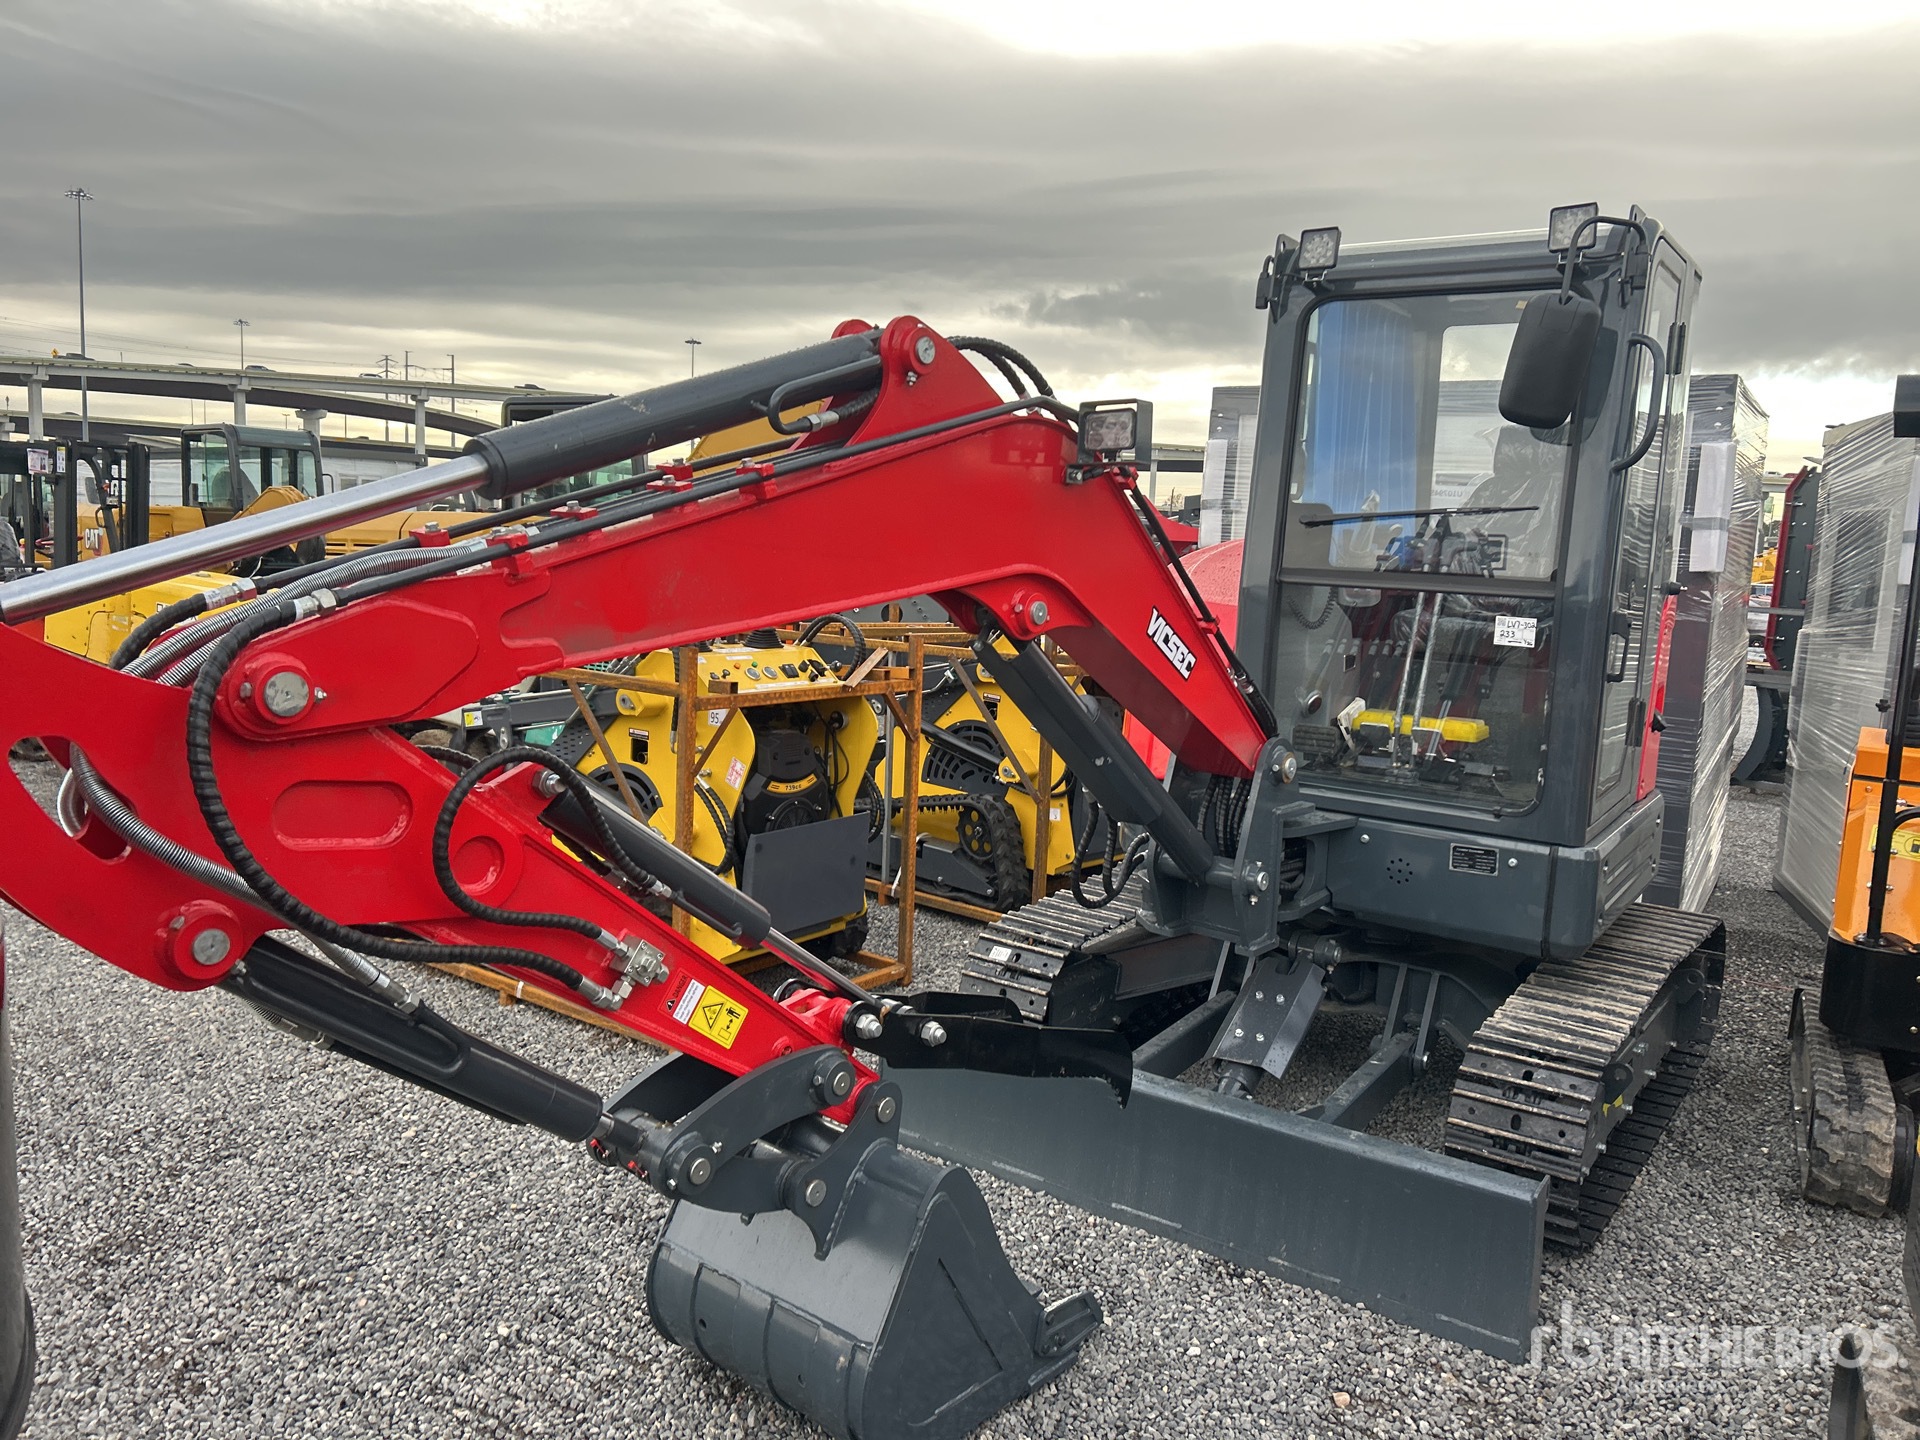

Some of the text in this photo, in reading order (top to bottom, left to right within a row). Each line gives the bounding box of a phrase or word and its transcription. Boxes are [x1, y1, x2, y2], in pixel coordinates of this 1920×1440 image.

[85, 528, 101, 550] CAT
[1147, 606, 1197, 680] VICSEC
[1499, 630, 1515, 638] 233
[672, 975, 688, 998] DANGER
